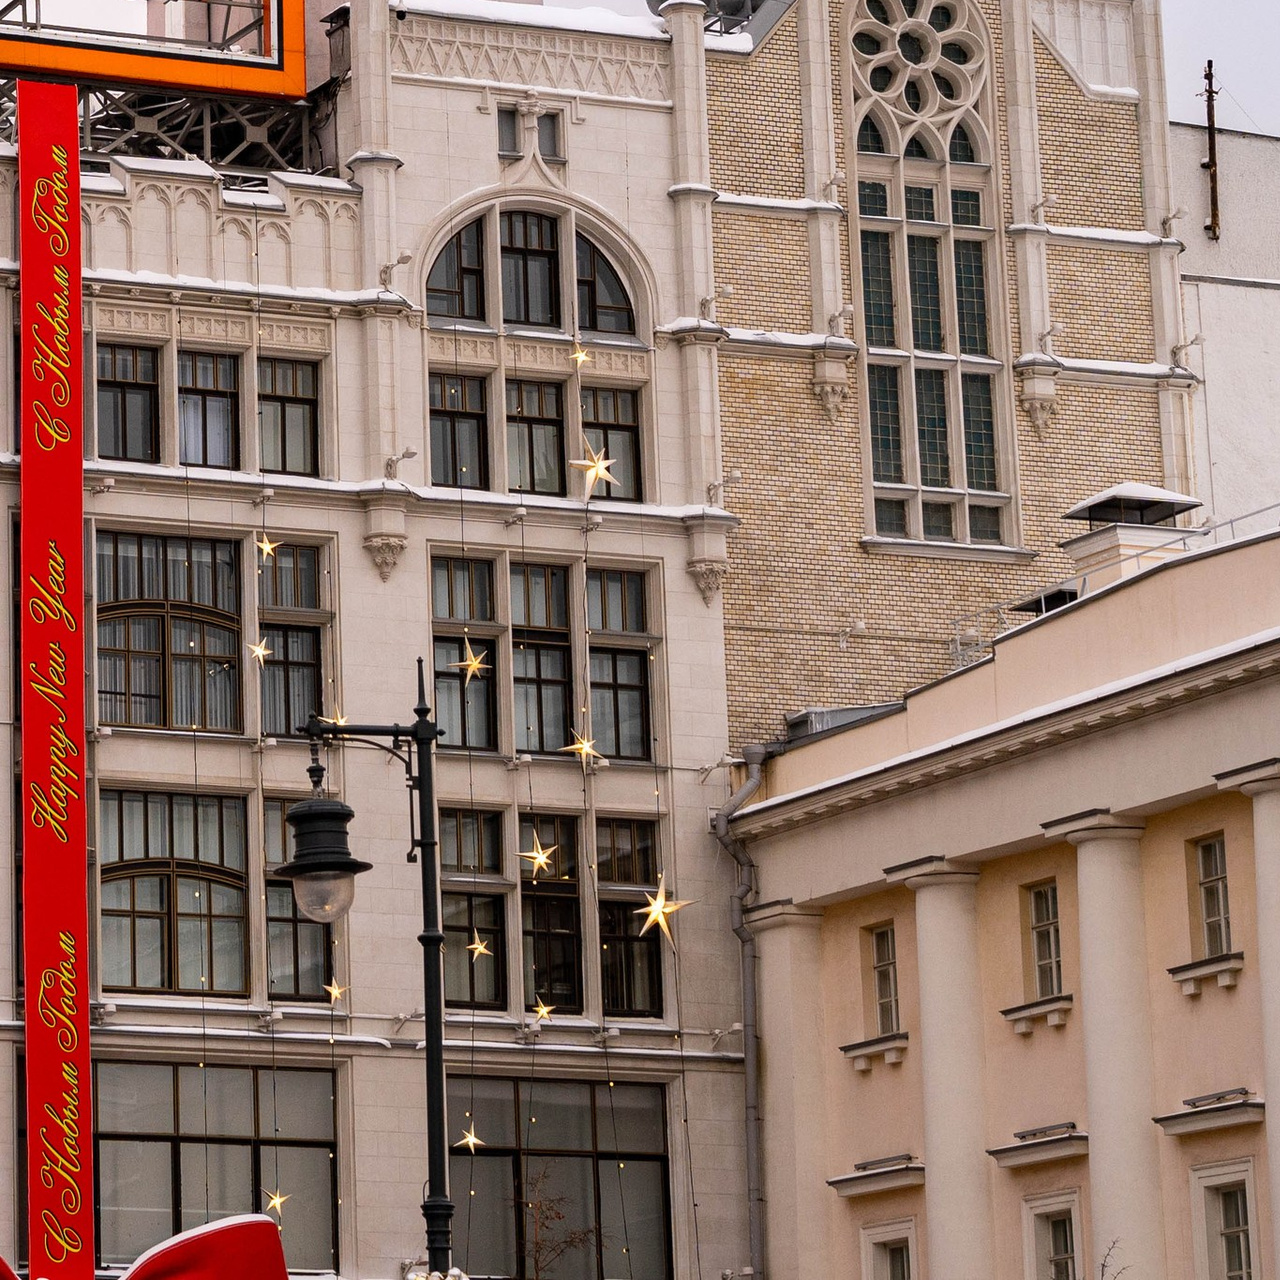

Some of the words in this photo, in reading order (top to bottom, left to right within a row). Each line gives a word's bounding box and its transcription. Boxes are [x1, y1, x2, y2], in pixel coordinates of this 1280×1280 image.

[31, 143, 70, 258] Годом
[31, 265, 72, 409] Новым
[33, 400, 72, 452] С
[29, 539, 78, 632] Year
[29, 641, 67, 724] New
[30, 724, 80, 844] Happy
[38, 930, 79, 1053] Годом
[40, 1061, 83, 1216] Новым
[43, 1209, 83, 1264] С
